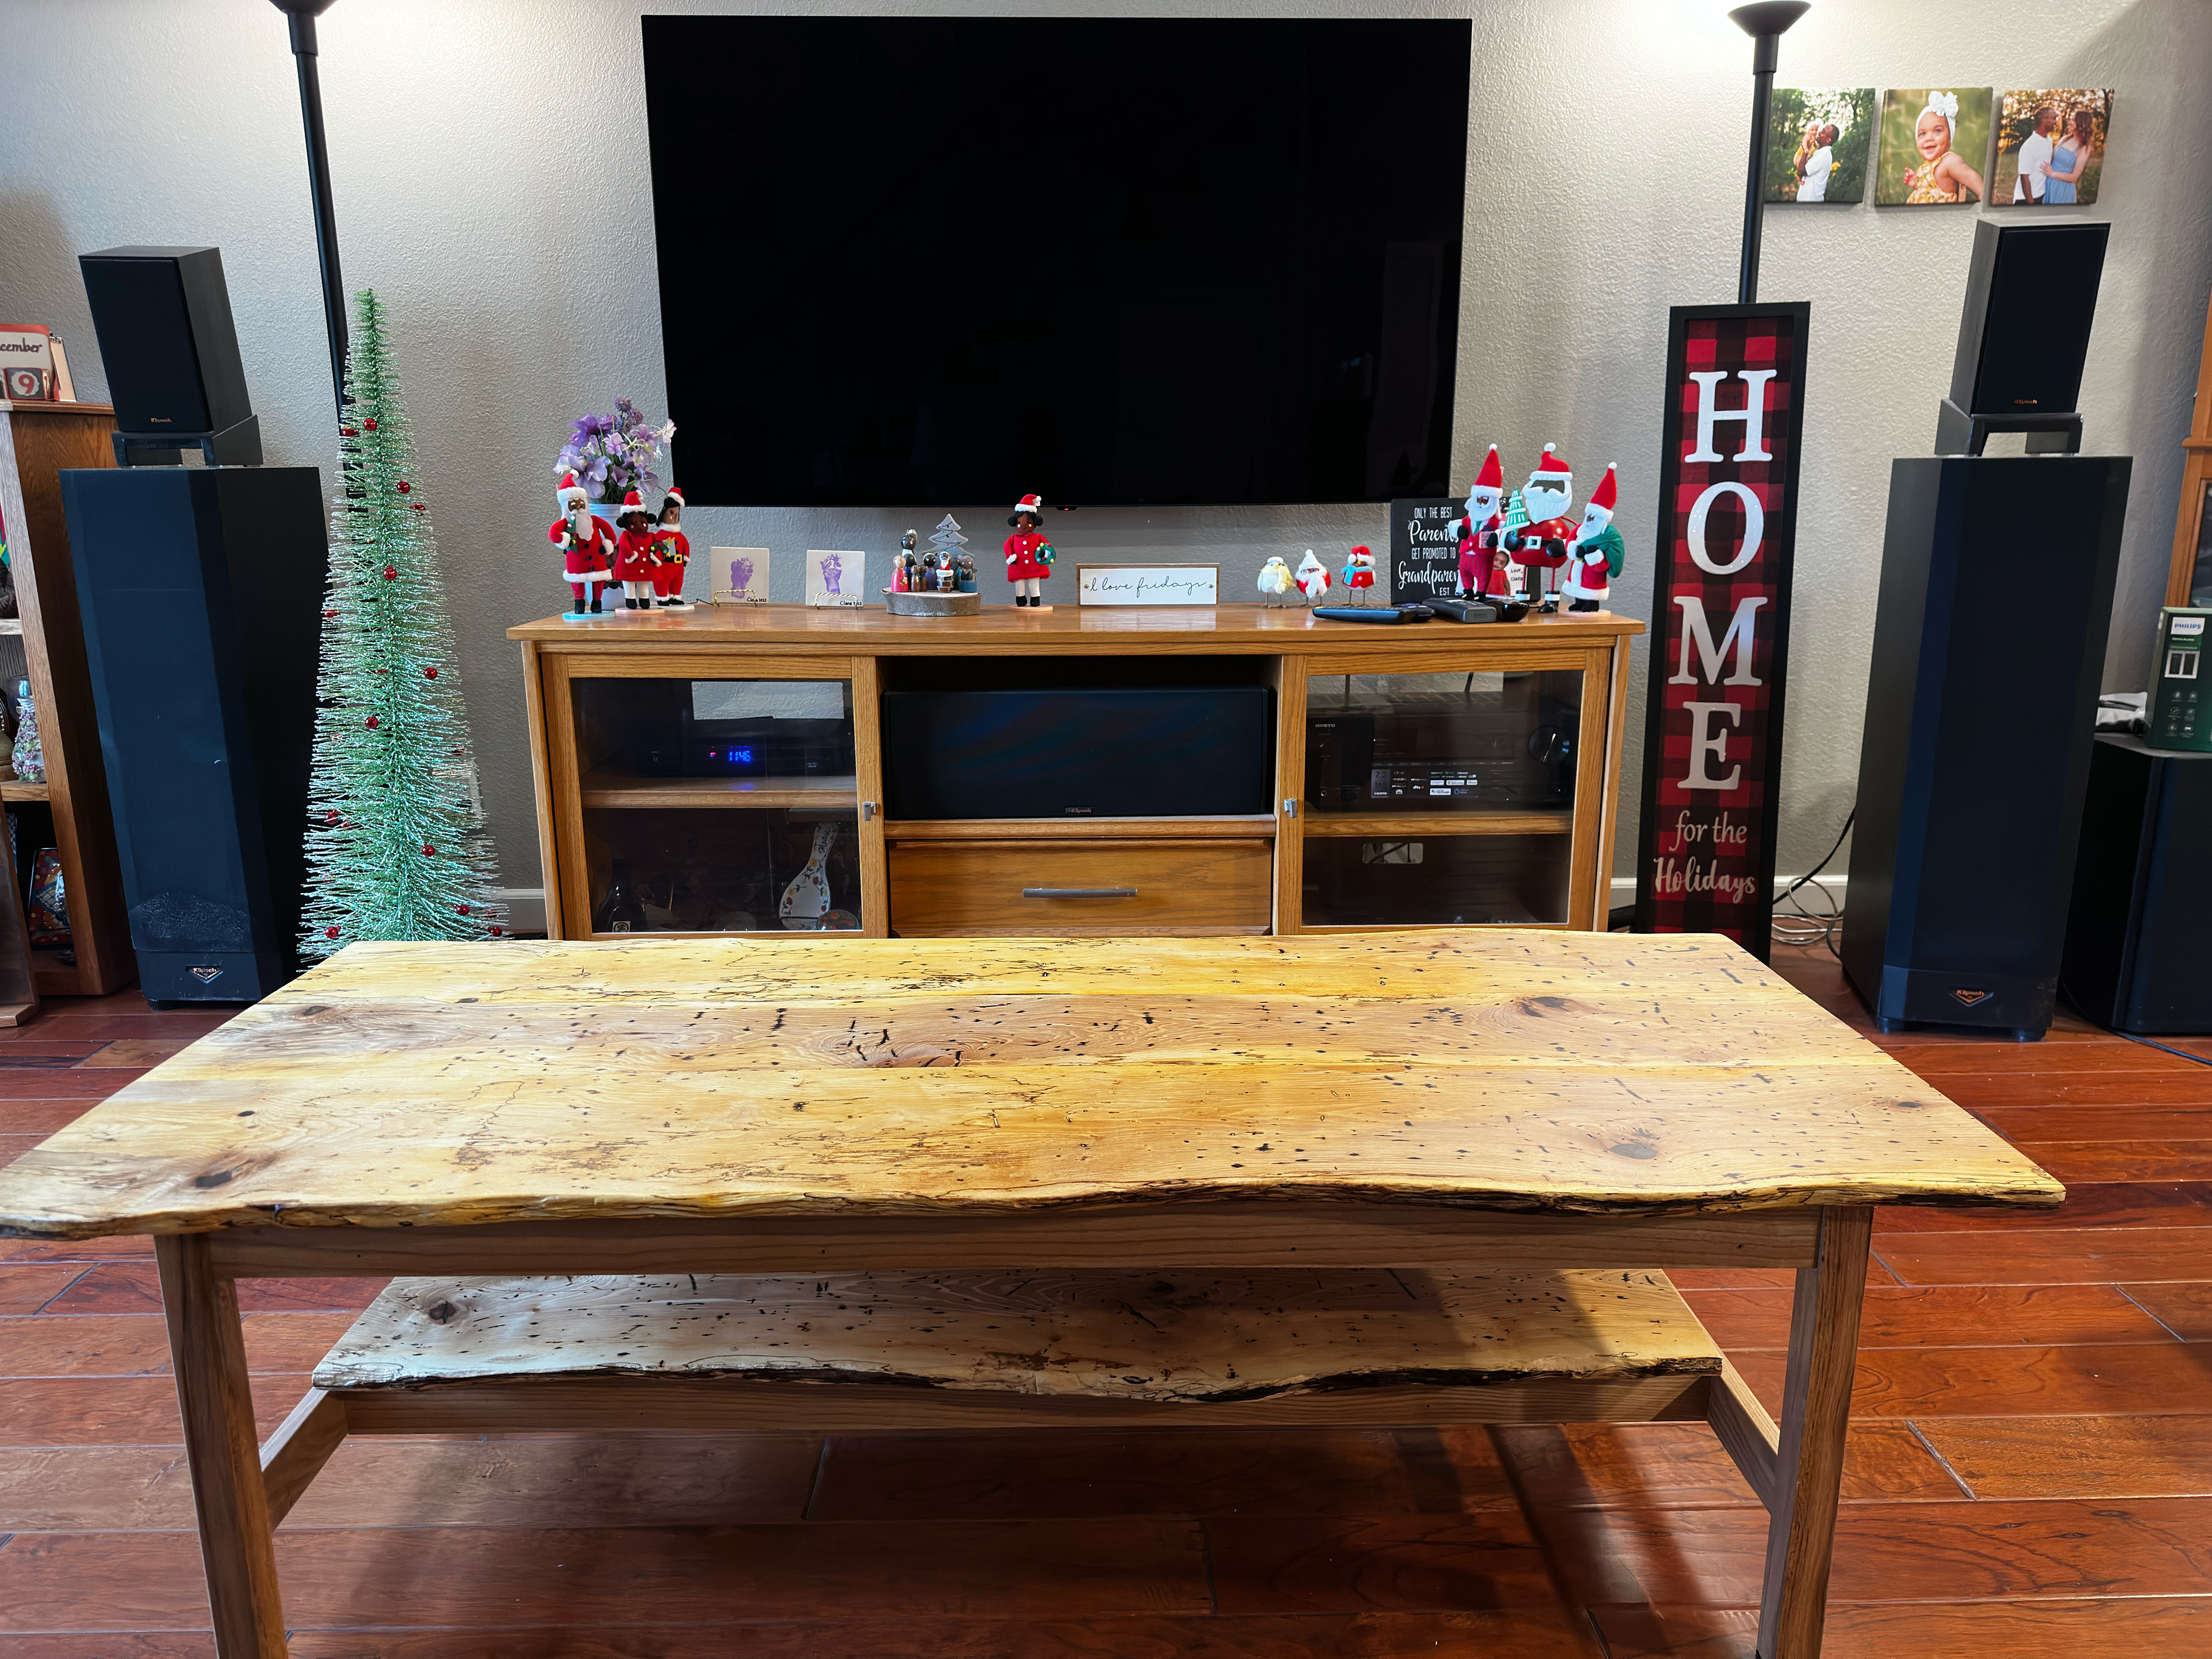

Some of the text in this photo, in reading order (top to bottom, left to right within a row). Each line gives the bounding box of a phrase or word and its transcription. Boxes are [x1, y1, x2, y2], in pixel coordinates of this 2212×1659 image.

[18, 374, 35, 395] 9
[1414, 507, 1453, 518] ONLY THE BEST
[1411, 547, 1456, 559] GET PROMOTED TO
[1101, 577, 1132, 591] love
[1137, 576, 1207, 599] fridays
[1668, 369, 1777, 790] HOME
[1669, 810, 1748, 851] for the
[1653, 856, 1756, 904] Holidays
